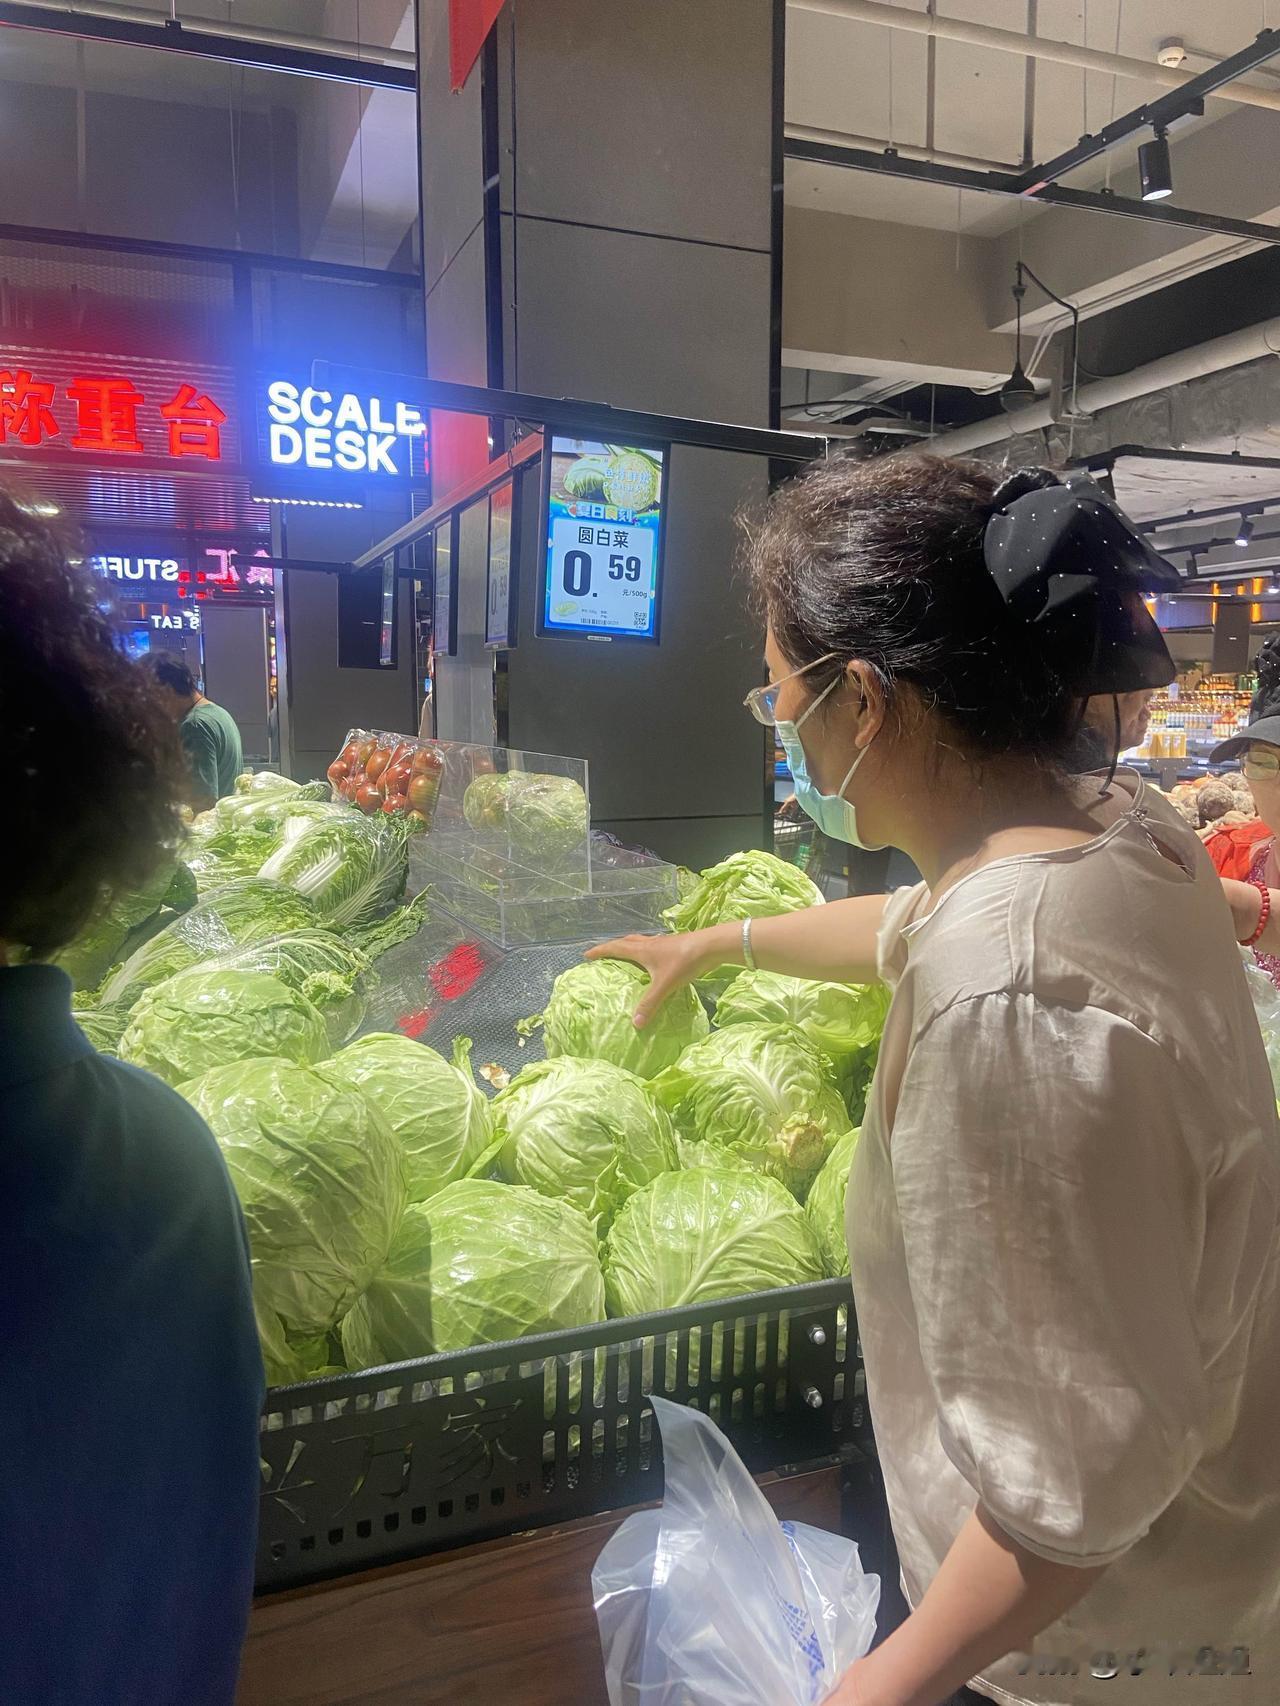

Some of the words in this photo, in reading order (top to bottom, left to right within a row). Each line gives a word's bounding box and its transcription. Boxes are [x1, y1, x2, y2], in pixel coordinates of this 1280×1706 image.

[0, 368, 227, 461] 称重台
[268, 381, 425, 436] SCALE
[270, 423, 399, 475] DESK
[578, 526, 630, 549] 圆白菜
[607, 553, 642, 582] 59
